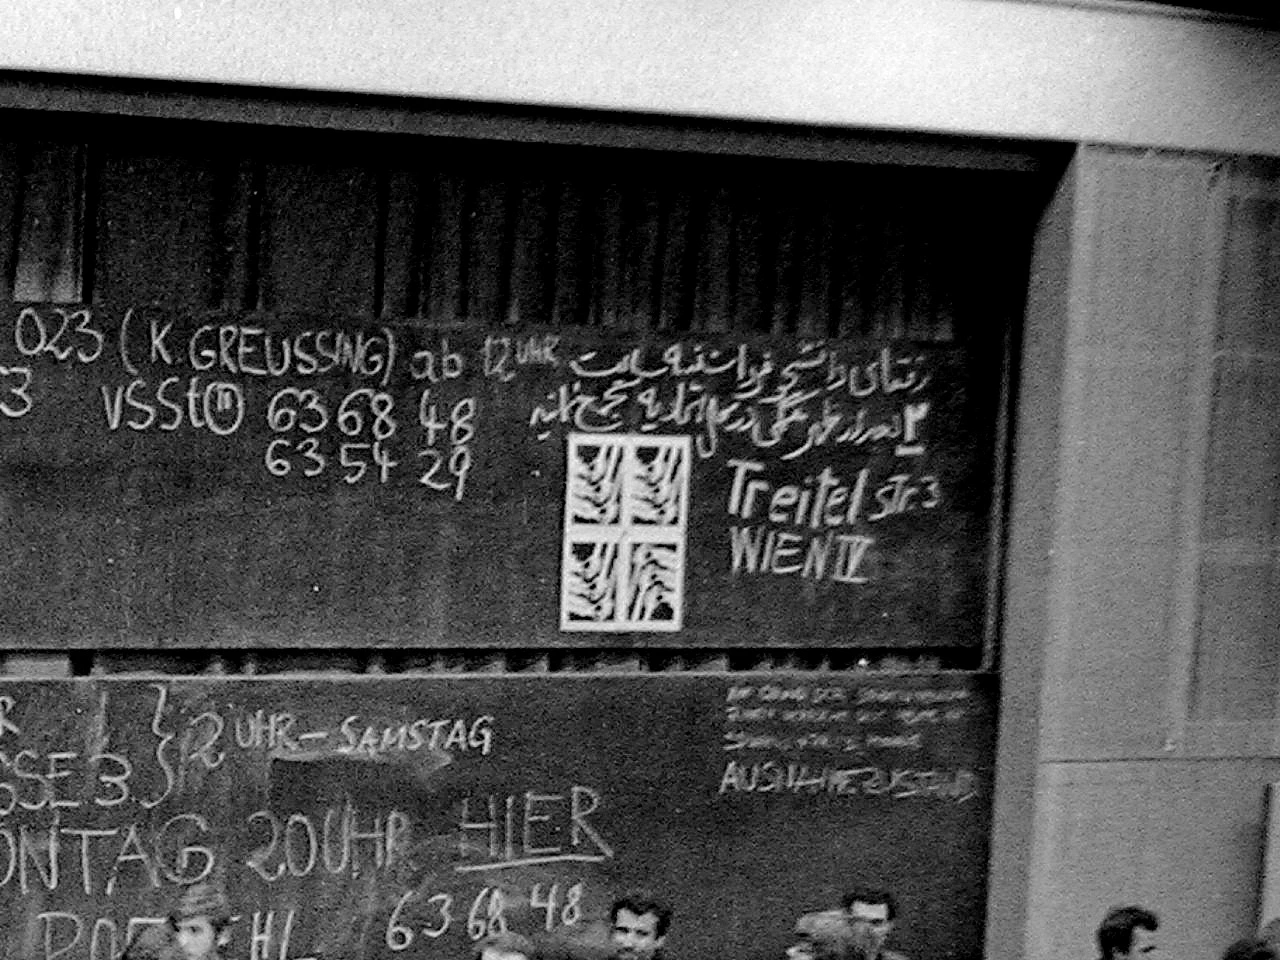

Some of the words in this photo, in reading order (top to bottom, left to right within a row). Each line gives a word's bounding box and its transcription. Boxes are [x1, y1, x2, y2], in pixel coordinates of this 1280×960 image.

[15, 306, 104, 362] 023
[411, 337, 464, 383] ab
[267, 386, 329, 434] 63
[337, 388, 397, 441] 68
[419, 389, 476, 446] 48
[264, 438, 326, 477] 63
[339, 441, 399, 484] 54
[419, 444, 473, 501] 29
[729, 525, 837, 580] WIEN
[336, 714, 496, 757] SAMSTAG
[460, 786, 613, 859] HIER
[468, 887, 507, 941] 68
[530, 883, 583, 931] 48
